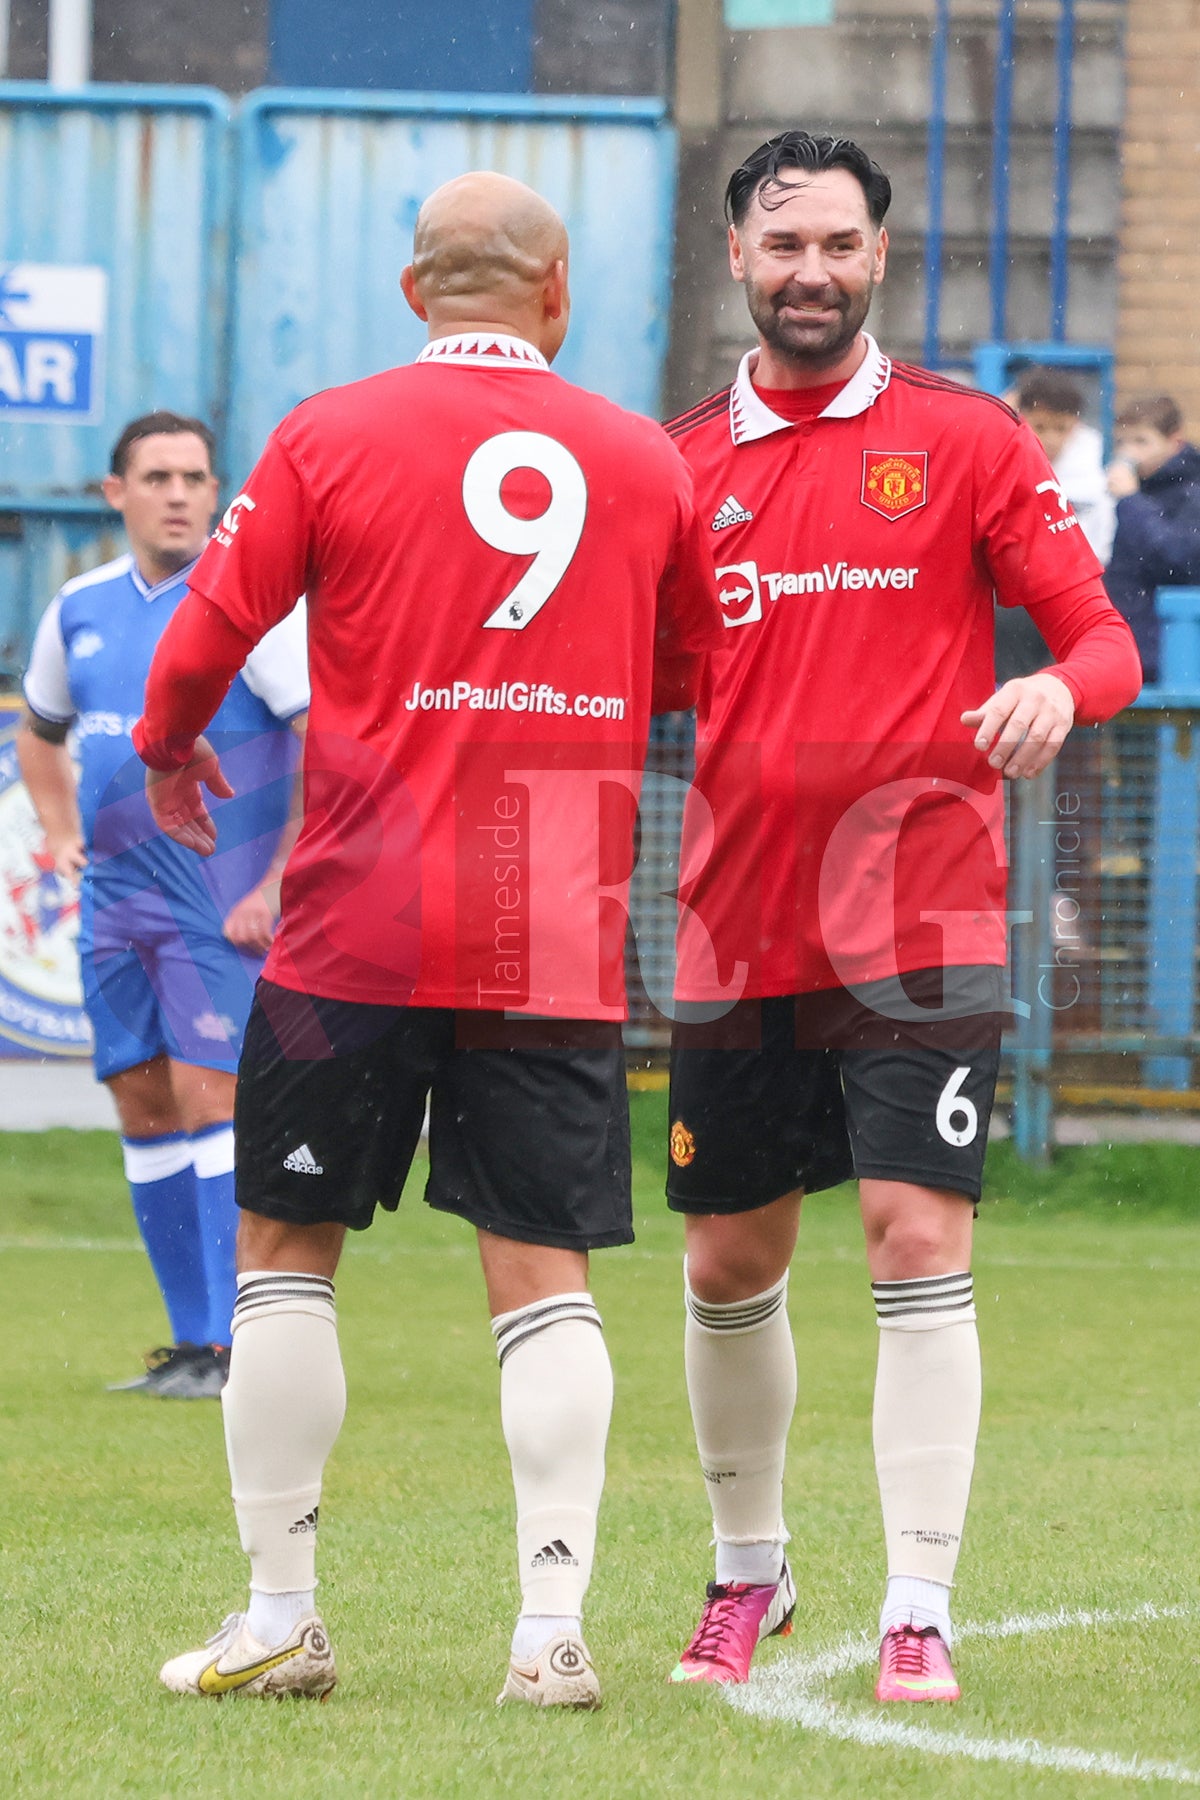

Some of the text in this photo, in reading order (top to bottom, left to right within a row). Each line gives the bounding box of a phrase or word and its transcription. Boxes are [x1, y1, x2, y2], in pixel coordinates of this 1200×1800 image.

[462, 431, 588, 630] 9
[711, 510, 753, 531] adidas
[405, 681, 625, 720] JonPaulGifts.com
[936, 1066, 978, 1148] 6
[283, 1159, 323, 1175] adidas
[916, 1536, 949, 1547] UNITED
[531, 1555, 579, 1567] adidas
